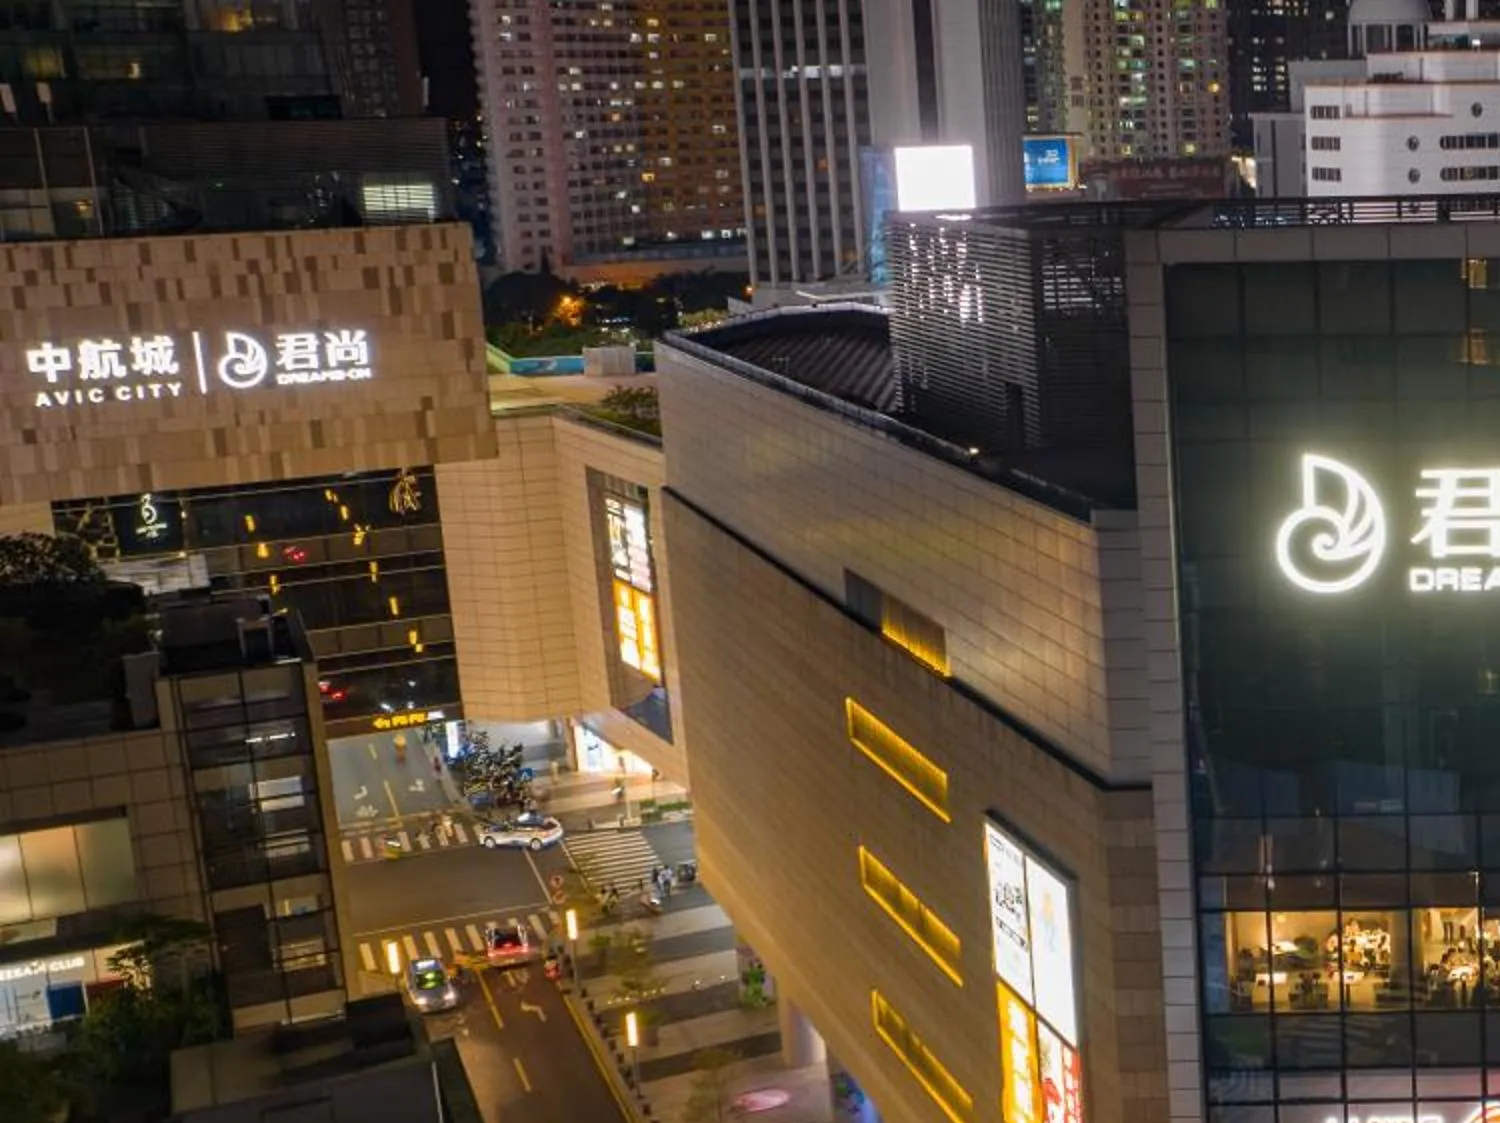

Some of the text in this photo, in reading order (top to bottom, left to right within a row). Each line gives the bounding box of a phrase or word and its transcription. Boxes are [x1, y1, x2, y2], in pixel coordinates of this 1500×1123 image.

[26, 335, 179, 382] 中航城
[276, 329, 370, 371] 君尚
[36, 382, 182, 407] AVIC CITY
